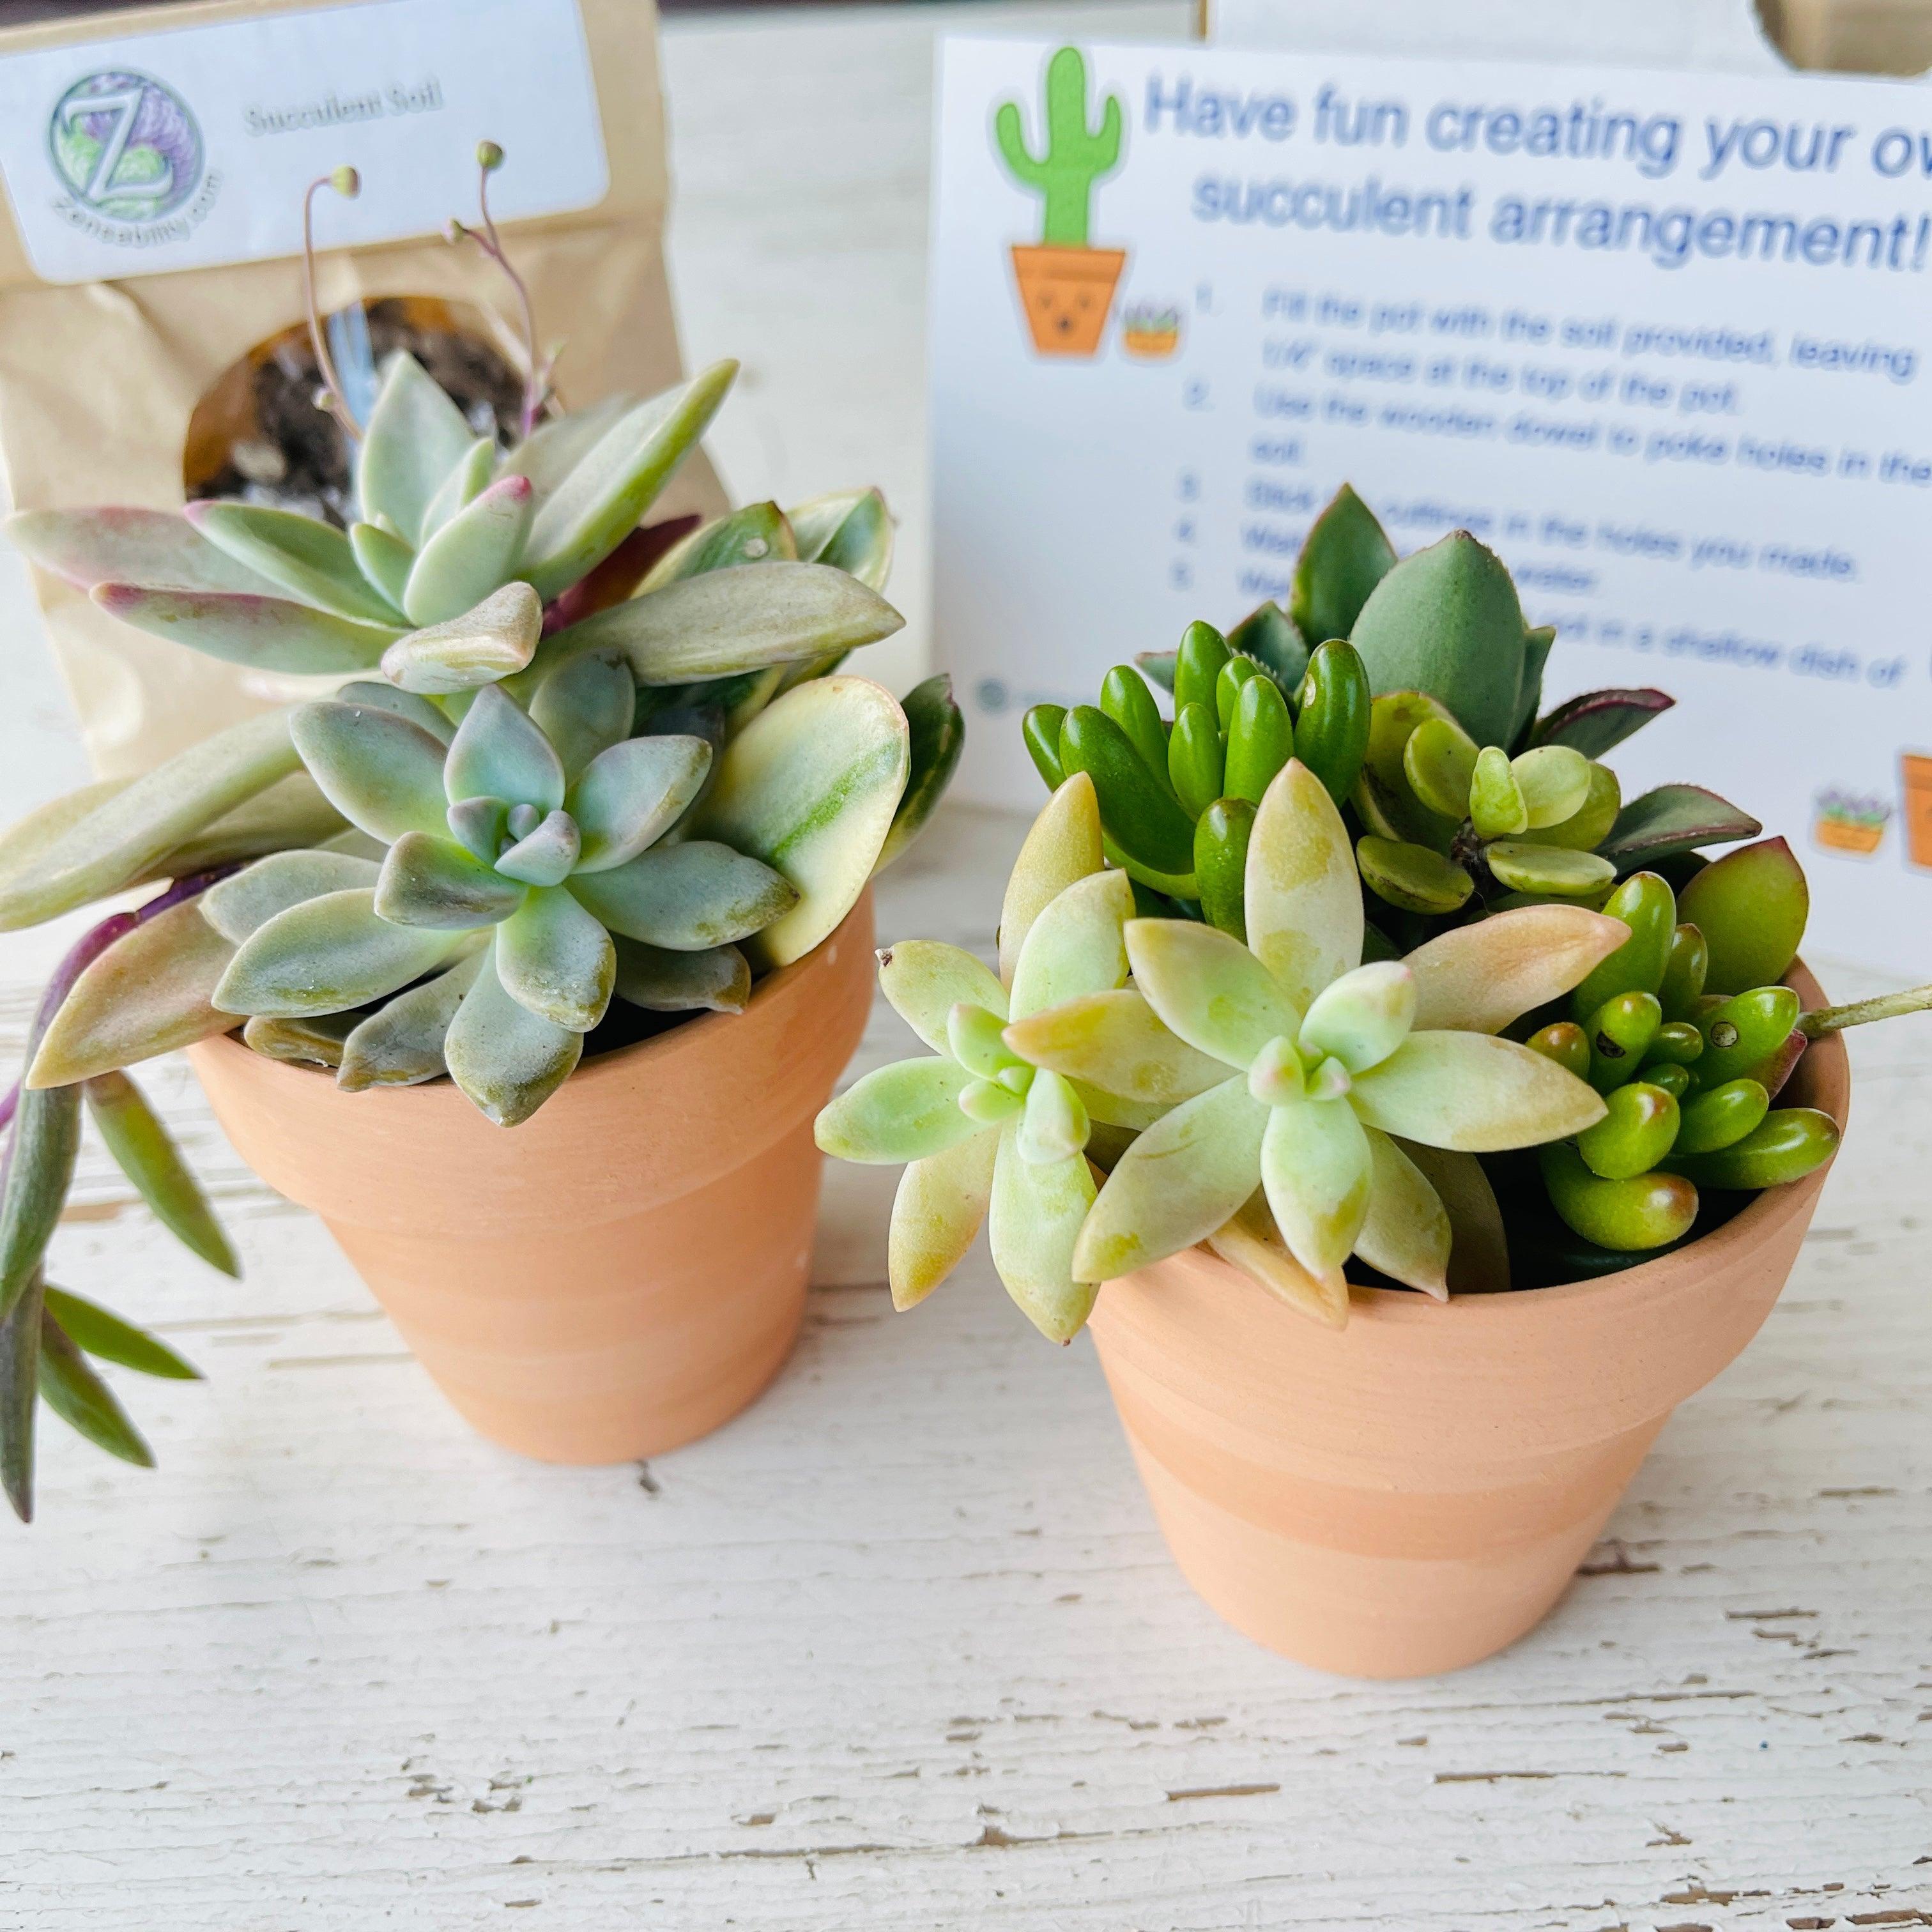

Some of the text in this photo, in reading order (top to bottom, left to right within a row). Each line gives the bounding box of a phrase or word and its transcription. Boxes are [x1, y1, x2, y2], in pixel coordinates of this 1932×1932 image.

[384, 76, 445, 116] Soil
[1144, 75, 1932, 181] Have fun creating your o
[1192, 174, 1931, 272] succulent arrangement!
[1791, 339, 1917, 383] leaving
